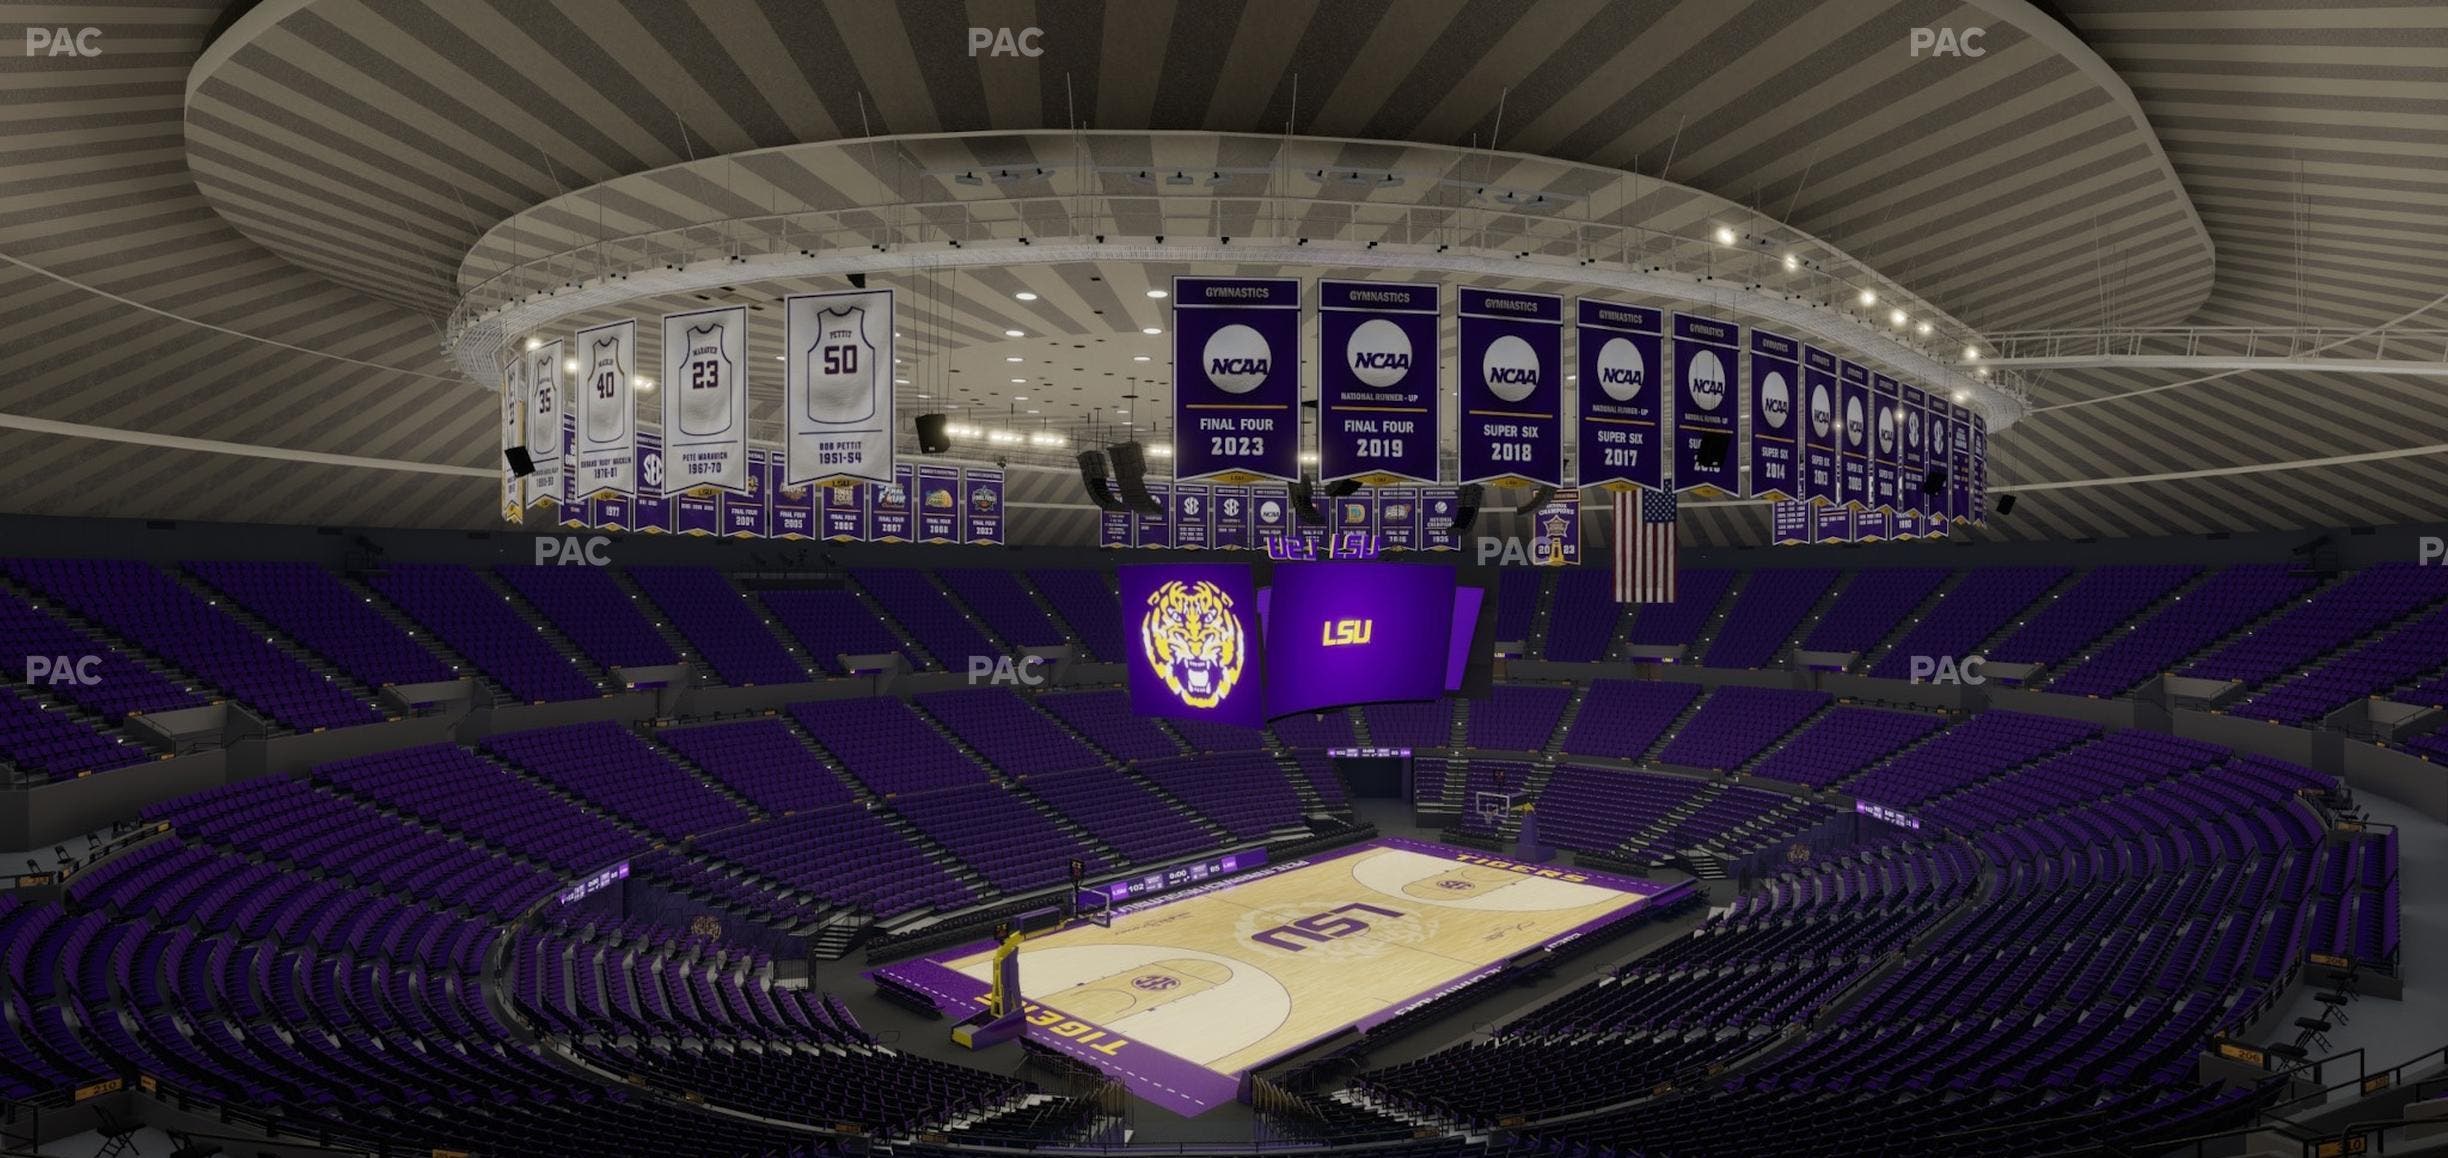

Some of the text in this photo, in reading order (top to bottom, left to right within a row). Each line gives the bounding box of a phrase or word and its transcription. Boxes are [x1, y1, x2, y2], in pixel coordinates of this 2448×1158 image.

[1205, 287, 1270, 299] GYMNASTICS
[1349, 290, 1410, 303] GYMNASTICS
[1485, 298, 1538, 312] GYMNASTICS
[1599, 309, 1643, 324] GYMNASTICS
[829, 330, 853, 339] PETTIT
[1689, 323, 1725, 338] GYMNASTICS
[824, 345, 858, 375] 50
[1211, 358, 1269, 375] NCAA
[1355, 352, 1409, 369] NCAA
[693, 360, 718, 390] 23
[1490, 367, 1537, 385] NCAA
[1603, 368, 1643, 386] NCAA
[597, 371, 614, 399] 40
[1693, 379, 1724, 397] NCAA
[539, 387, 551, 414] 35
[1341, 392, 1374, 401] NATIONAL
[1765, 398, 1788, 416] NCAA
[1200, 418, 1274, 431] FINAL FOUR
[1344, 419, 1414, 433] FINAL FOUR
[1483, 423, 1539, 438] SUPER SIX
[1598, 430, 1644, 444] SUPER SIX
[820, 441, 862, 451] BOB PETTIT
[1211, 437, 1265, 456] 2023
[1356, 439, 1403, 458] 2019
[1491, 442, 1532, 462] 2018
[1761, 446, 1789, 460] SUPER SIX
[683, 452, 728, 462] PETE MARAVICH
[820, 452, 862, 465] 1951-54
[1604, 448, 1638, 467] 2017
[688, 462, 722, 475] 1967-70
[1766, 462, 1786, 480] 2014
[1183, 496, 1200, 515] SEC
[1223, 498, 1240, 516] SEC
[1538, 508, 1575, 516] CHAMPIONS
[882, 524, 902, 533] 2007
[1538, 544, 1575, 555] 20 23
[1323, 620, 1372, 646] LSU
[1169, 869, 1187, 880] 0:00
[1456, 853, 1590, 883] TIGERS
[1128, 883, 1144, 893] 102
[1251, 902, 1405, 952] LSU
